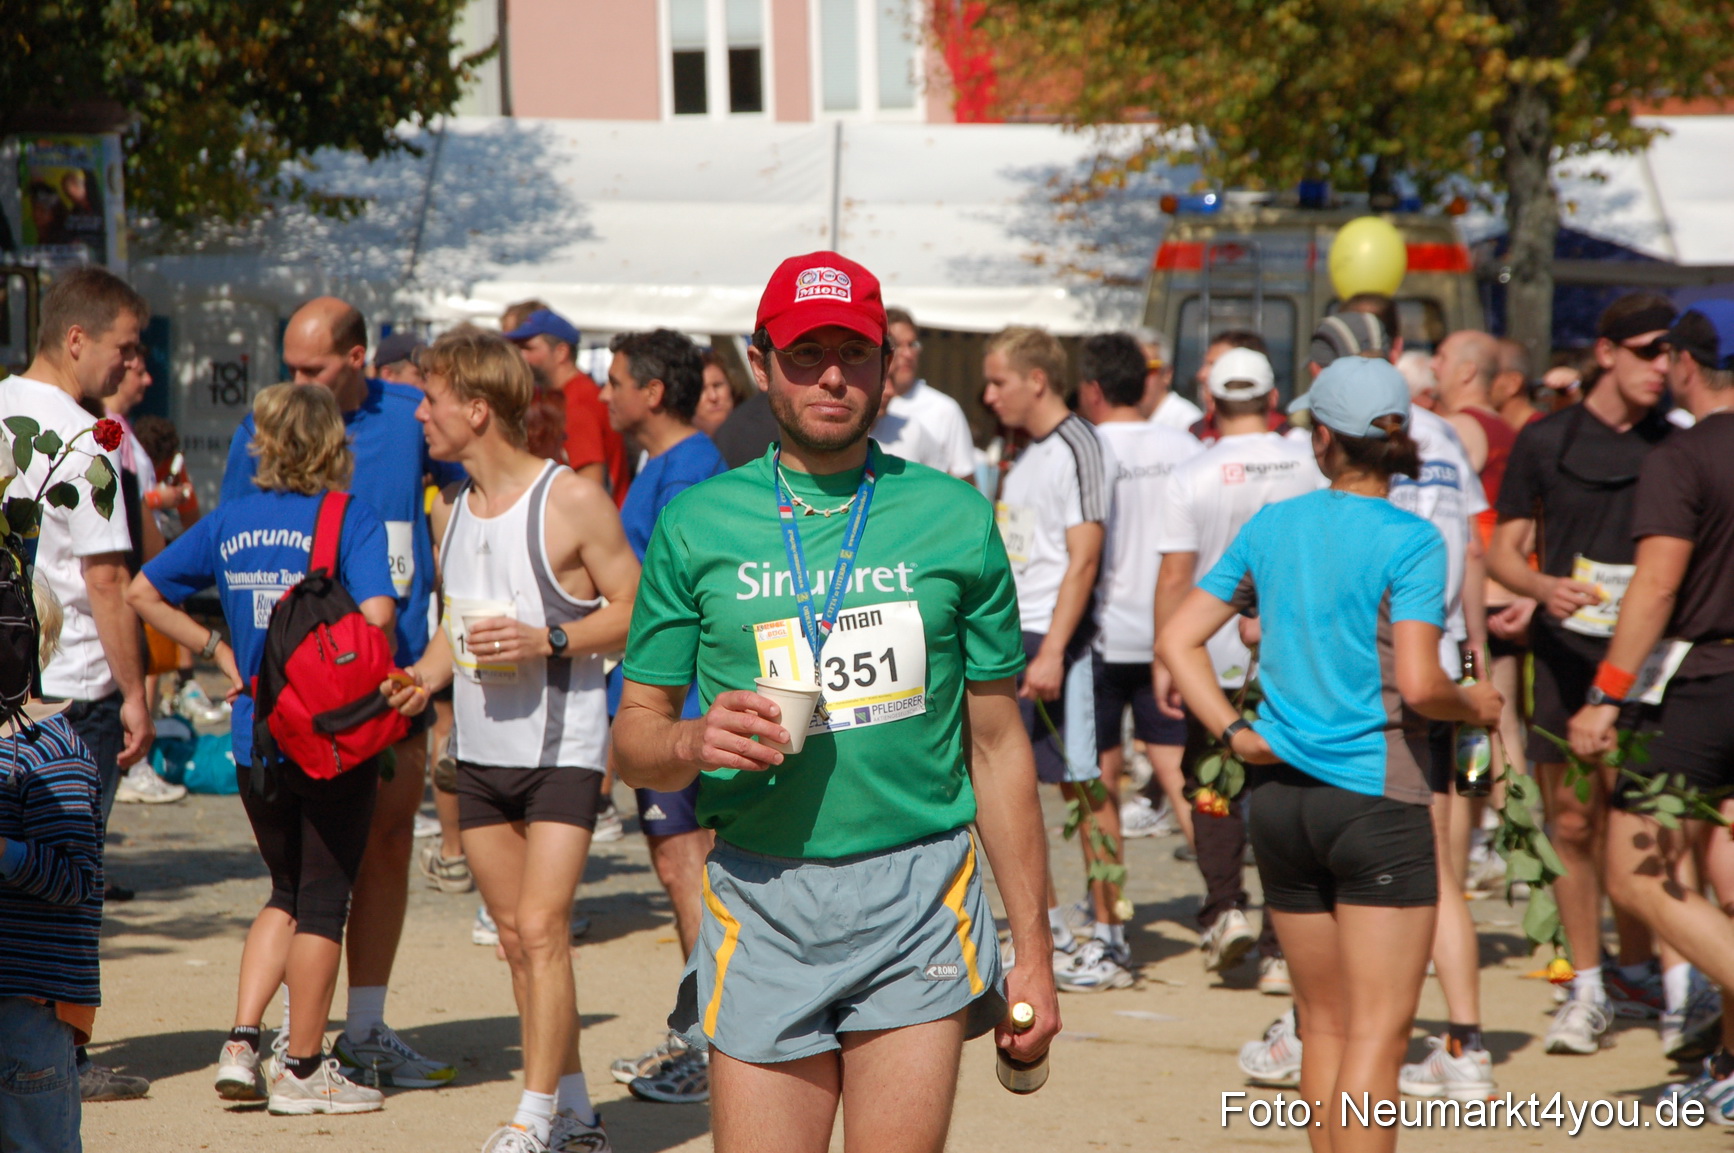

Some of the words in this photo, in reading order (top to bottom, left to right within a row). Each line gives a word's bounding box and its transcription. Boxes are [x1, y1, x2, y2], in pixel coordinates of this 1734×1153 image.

[800, 285, 847, 298] Miele
[769, 659, 779, 678] A
[824, 647, 898, 692] 351
[872, 694, 923, 716] PFLEIDERER
